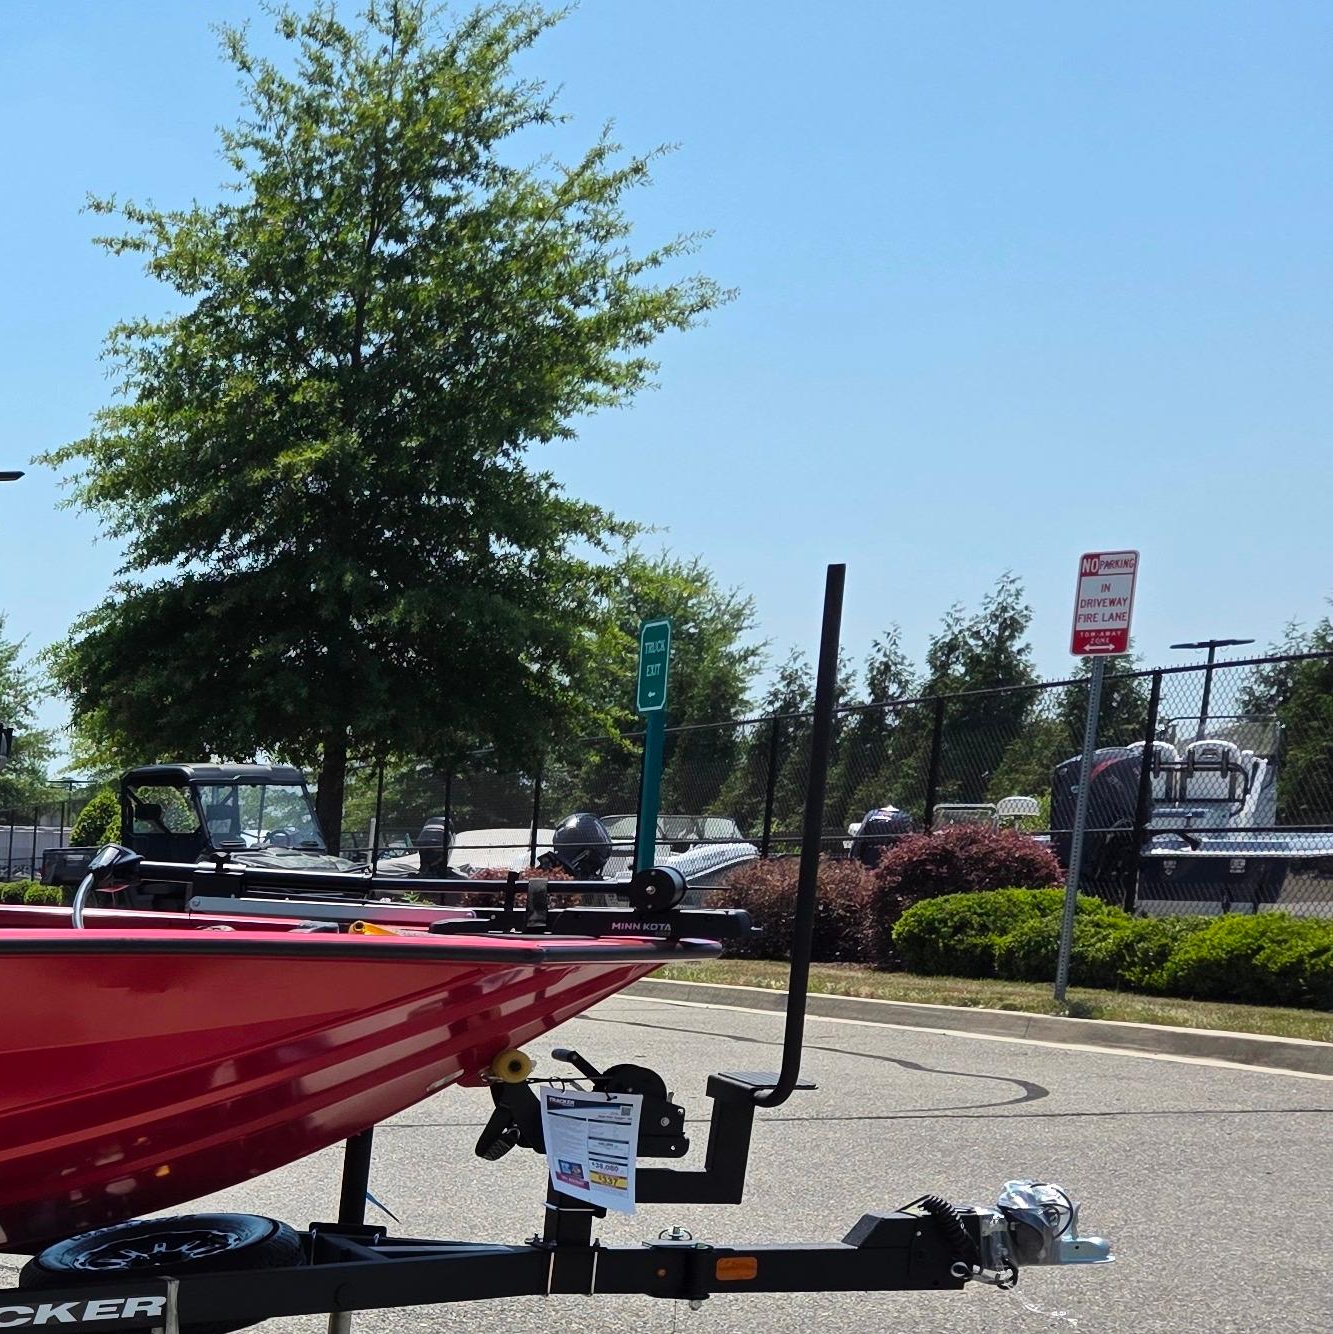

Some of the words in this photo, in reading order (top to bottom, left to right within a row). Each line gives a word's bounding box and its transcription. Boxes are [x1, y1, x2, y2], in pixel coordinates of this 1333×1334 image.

[1082, 558, 1099, 573] NO
[1099, 559, 1134, 570] PARKING
[1101, 583, 1111, 593] IN
[1080, 597, 1128, 609] DRIVEWAY
[1078, 612, 1099, 623] FIRE
[1102, 611, 1128, 622] LANE
[645, 639, 666, 654] TRUCK
[646, 663, 662, 677] EXIT
[612, 922, 641, 930] MINN
[642, 922, 671, 931] KOTA
